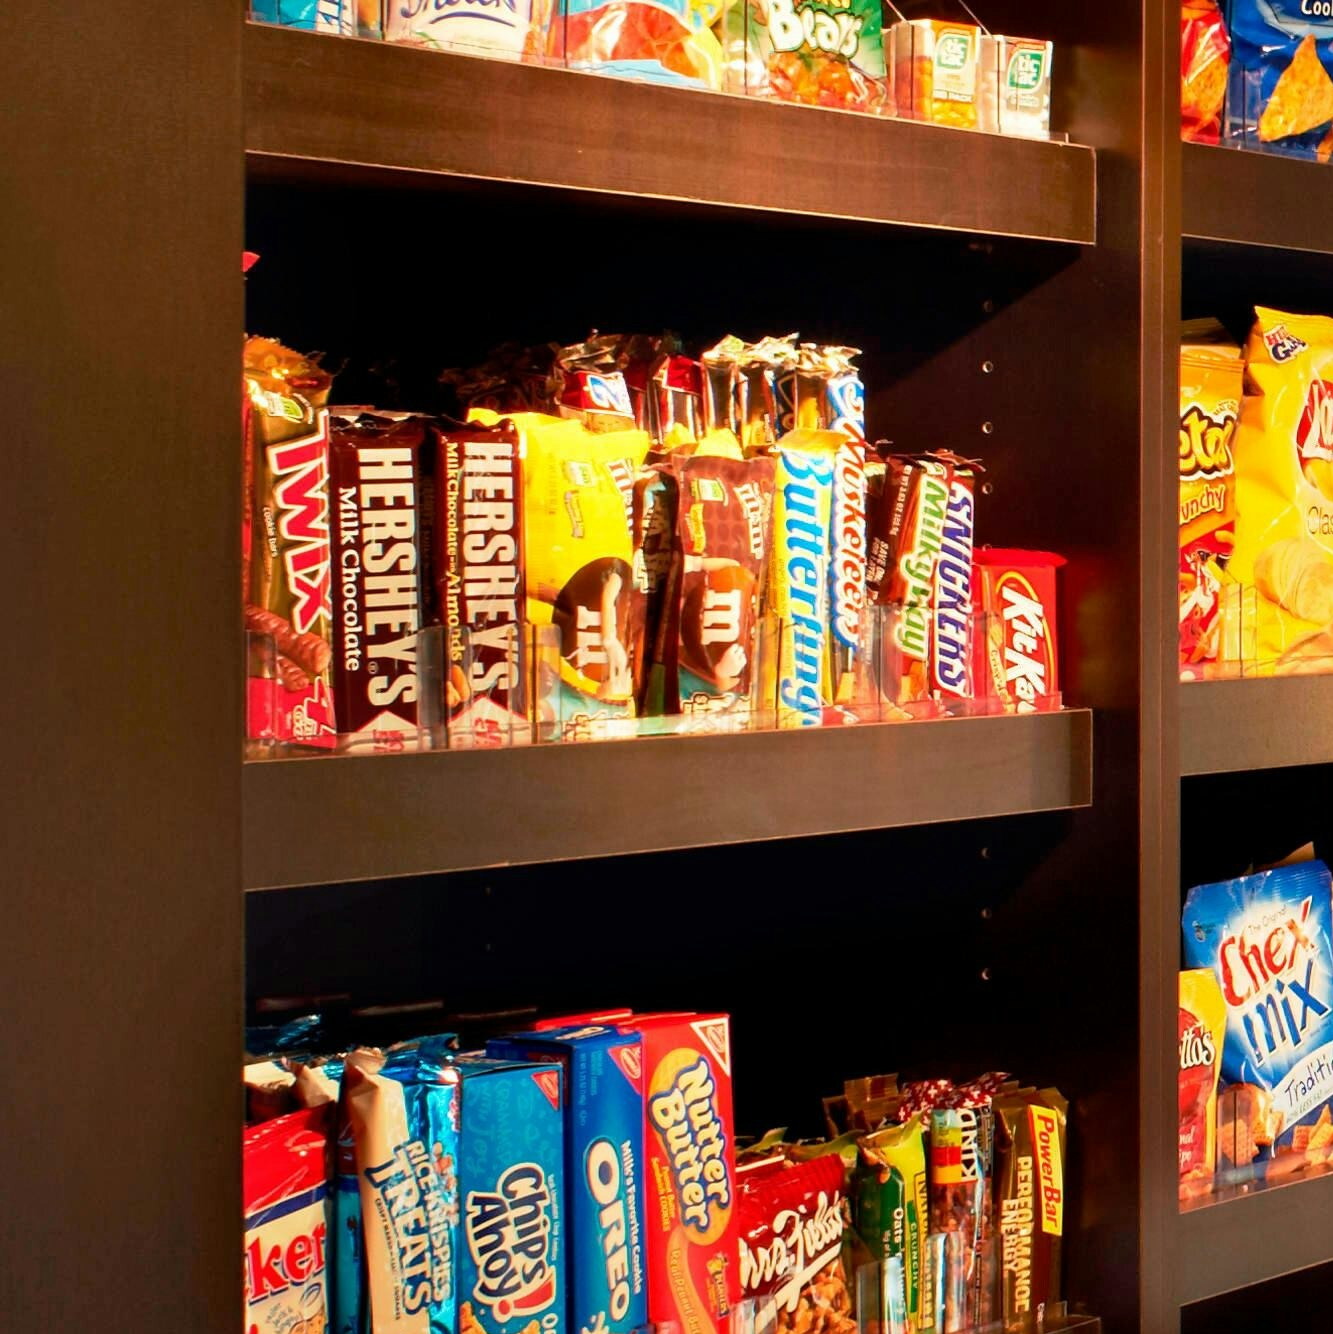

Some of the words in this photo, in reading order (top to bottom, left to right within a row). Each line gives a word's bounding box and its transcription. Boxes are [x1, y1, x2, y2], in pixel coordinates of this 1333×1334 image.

[339, 487, 357, 545] Milk
[445, 442, 458, 473] Milk
[358, 447, 418, 707] HERSHEY'S
[463, 441, 520, 691] HERSHEY'S
[902, 479, 948, 584] Milky
[936, 482, 974, 698] SNICKERS
[341, 549, 361, 672] Chocolate
[1002, 586, 1043, 655] Kit
[1217, 896, 1312, 1008] Chex
[653, 1088, 708, 1232] Butter
[679, 1060, 730, 1210] Nutter
[960, 1110, 978, 1181] KIND
[1036, 1112, 1062, 1232] PowerBar
[364, 1156, 431, 1318] TREATS
[501, 1165, 548, 1286] Chips
[586, 1140, 631, 1322] OREO
